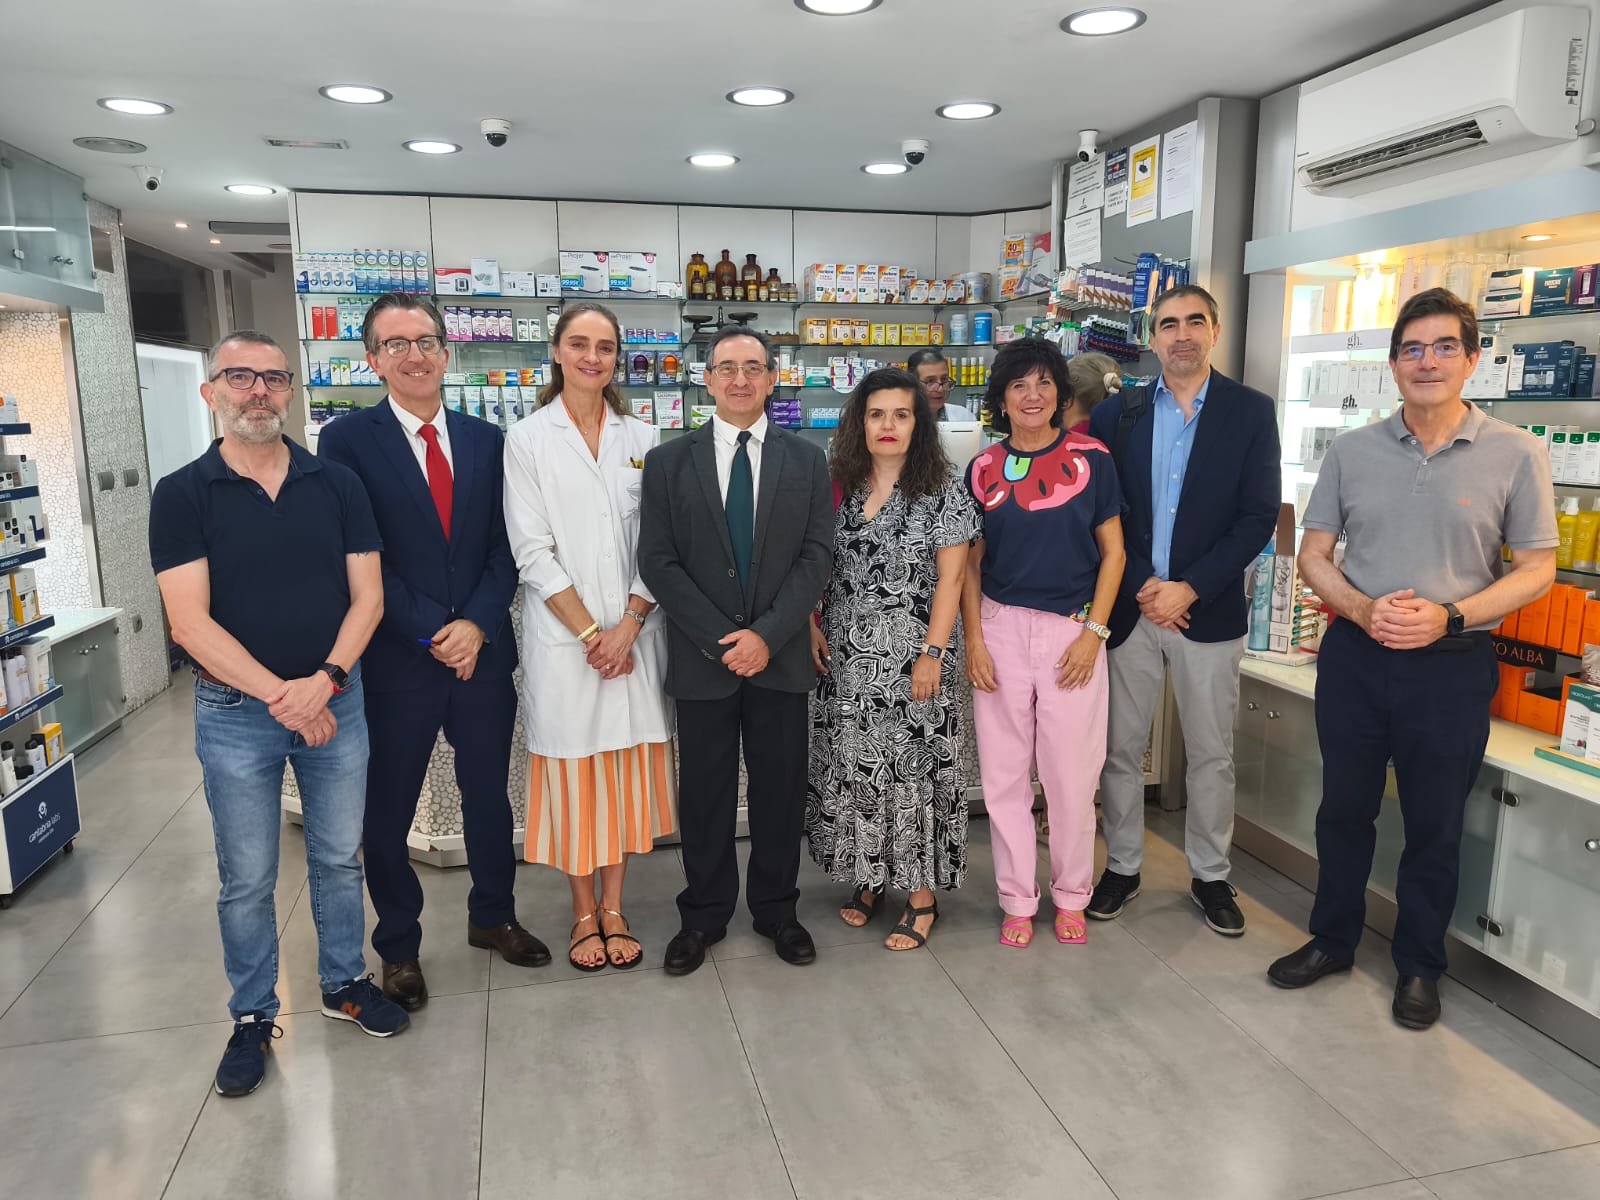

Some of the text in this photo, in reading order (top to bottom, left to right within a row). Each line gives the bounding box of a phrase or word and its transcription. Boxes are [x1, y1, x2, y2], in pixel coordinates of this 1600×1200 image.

[1346, 332, 1363, 350] gh.
[1341, 394, 1358, 410] gh.
[1510, 647, 1544, 665] ALBA
